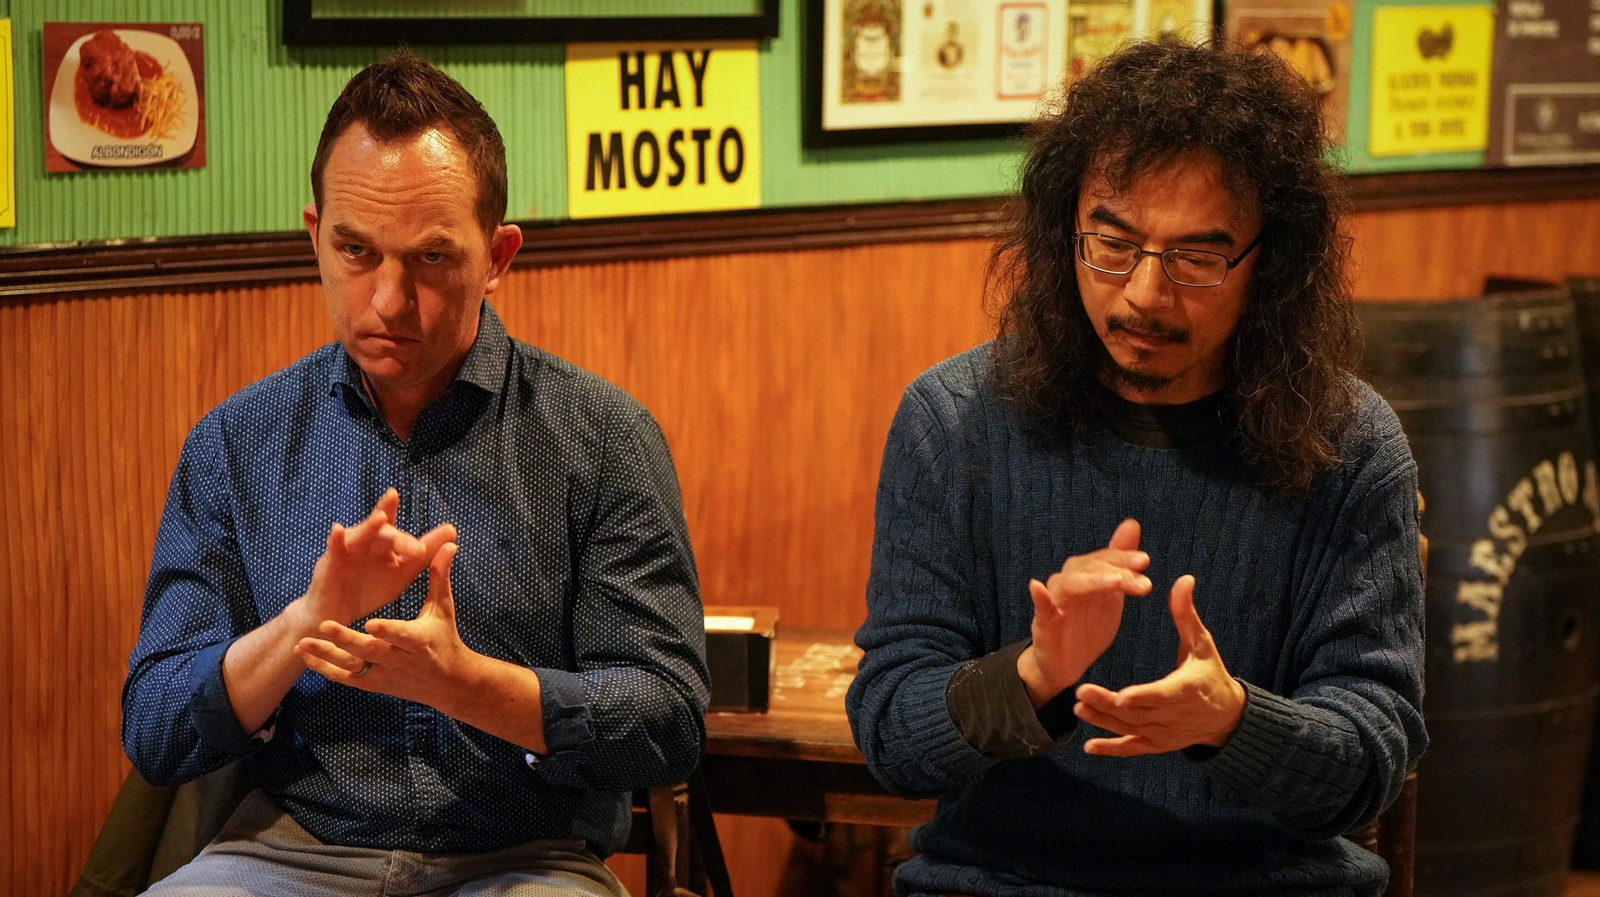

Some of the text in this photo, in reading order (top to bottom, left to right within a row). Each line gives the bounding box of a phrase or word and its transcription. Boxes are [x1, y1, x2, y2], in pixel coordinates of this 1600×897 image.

[618, 48, 712, 110] HAY
[585, 127, 744, 191] MOSTO
[1450, 451, 1579, 662] MAESTRO
